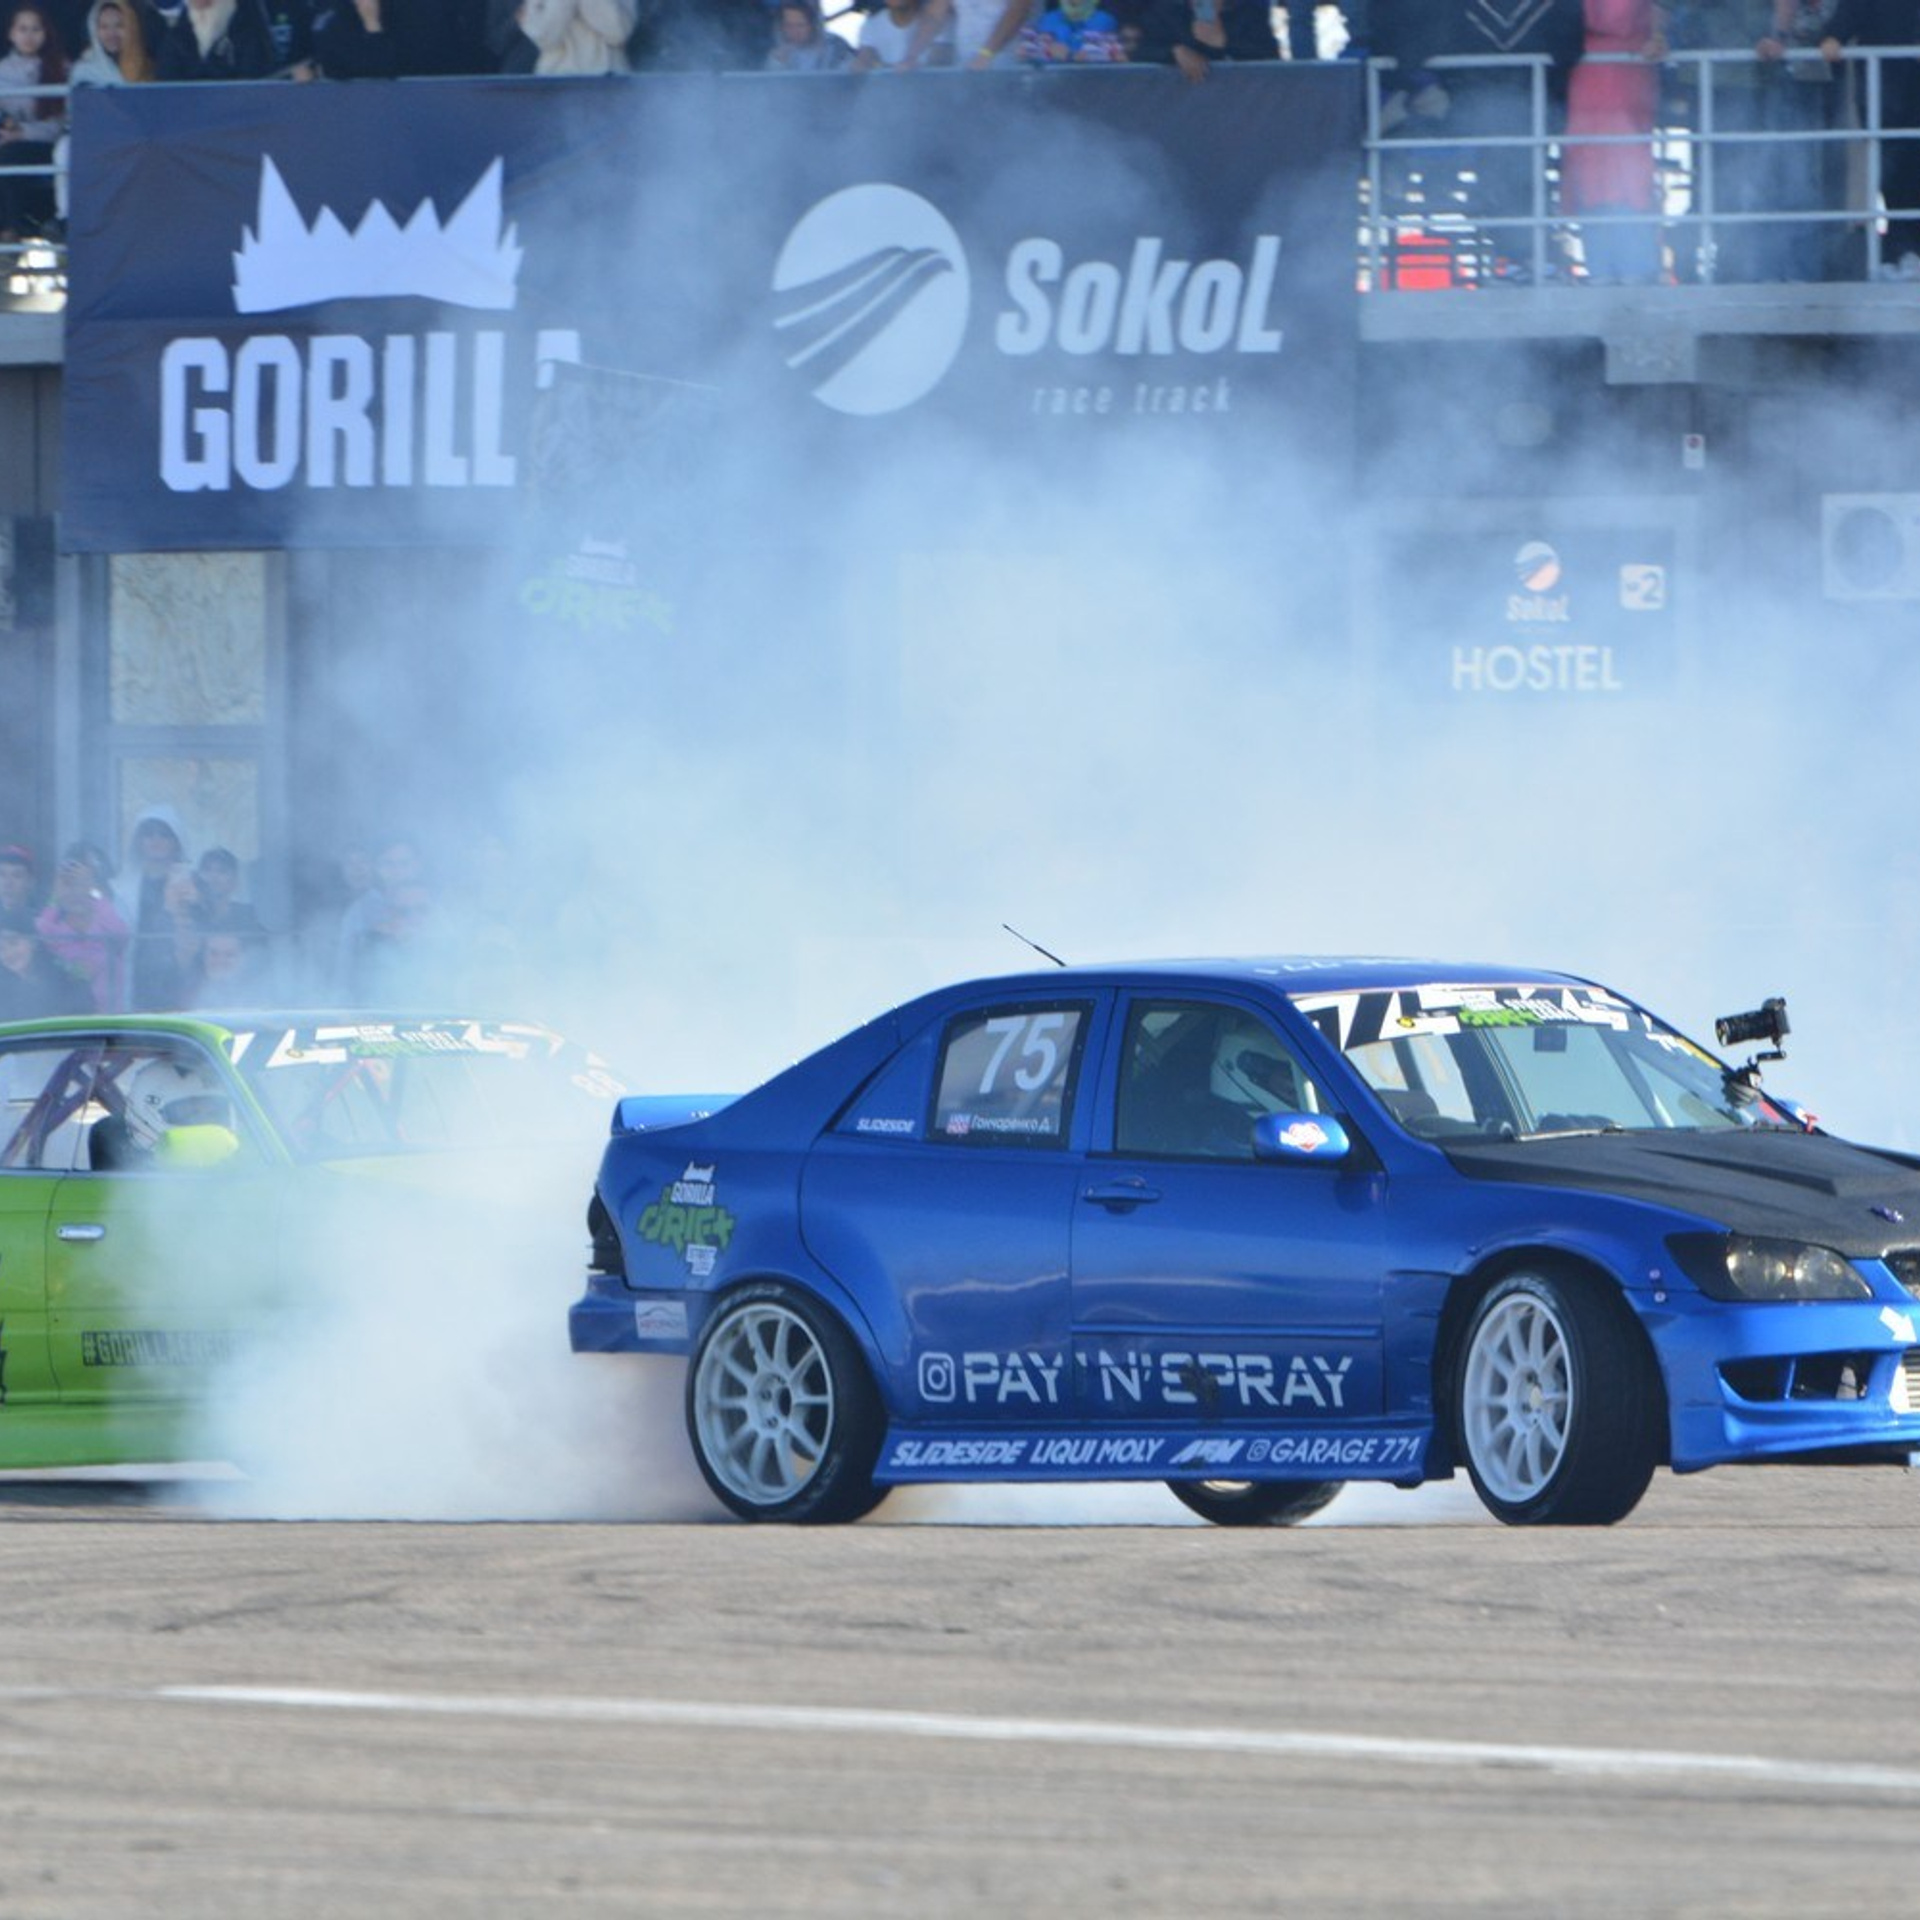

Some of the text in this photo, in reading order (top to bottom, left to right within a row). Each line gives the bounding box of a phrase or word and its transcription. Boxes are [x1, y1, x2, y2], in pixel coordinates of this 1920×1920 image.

[1031, 376, 1232, 414] race track
[1451, 645, 1623, 691] HOSTEL
[979, 1013, 1066, 1094] 75
[856, 1118, 916, 1132] SLIDESIDE
[671, 1181, 716, 1206] GORILLA
[963, 1352, 1064, 1403] PAY
[1161, 1352, 1353, 1407] SPRAY
[891, 1440, 1027, 1466] SLIDESIDE
[1030, 1440, 1098, 1464] LIQUI
[1095, 1439, 1165, 1464] MOLY
[1270, 1438, 1377, 1463] GARAGE
[1377, 1436, 1421, 1462] 771
